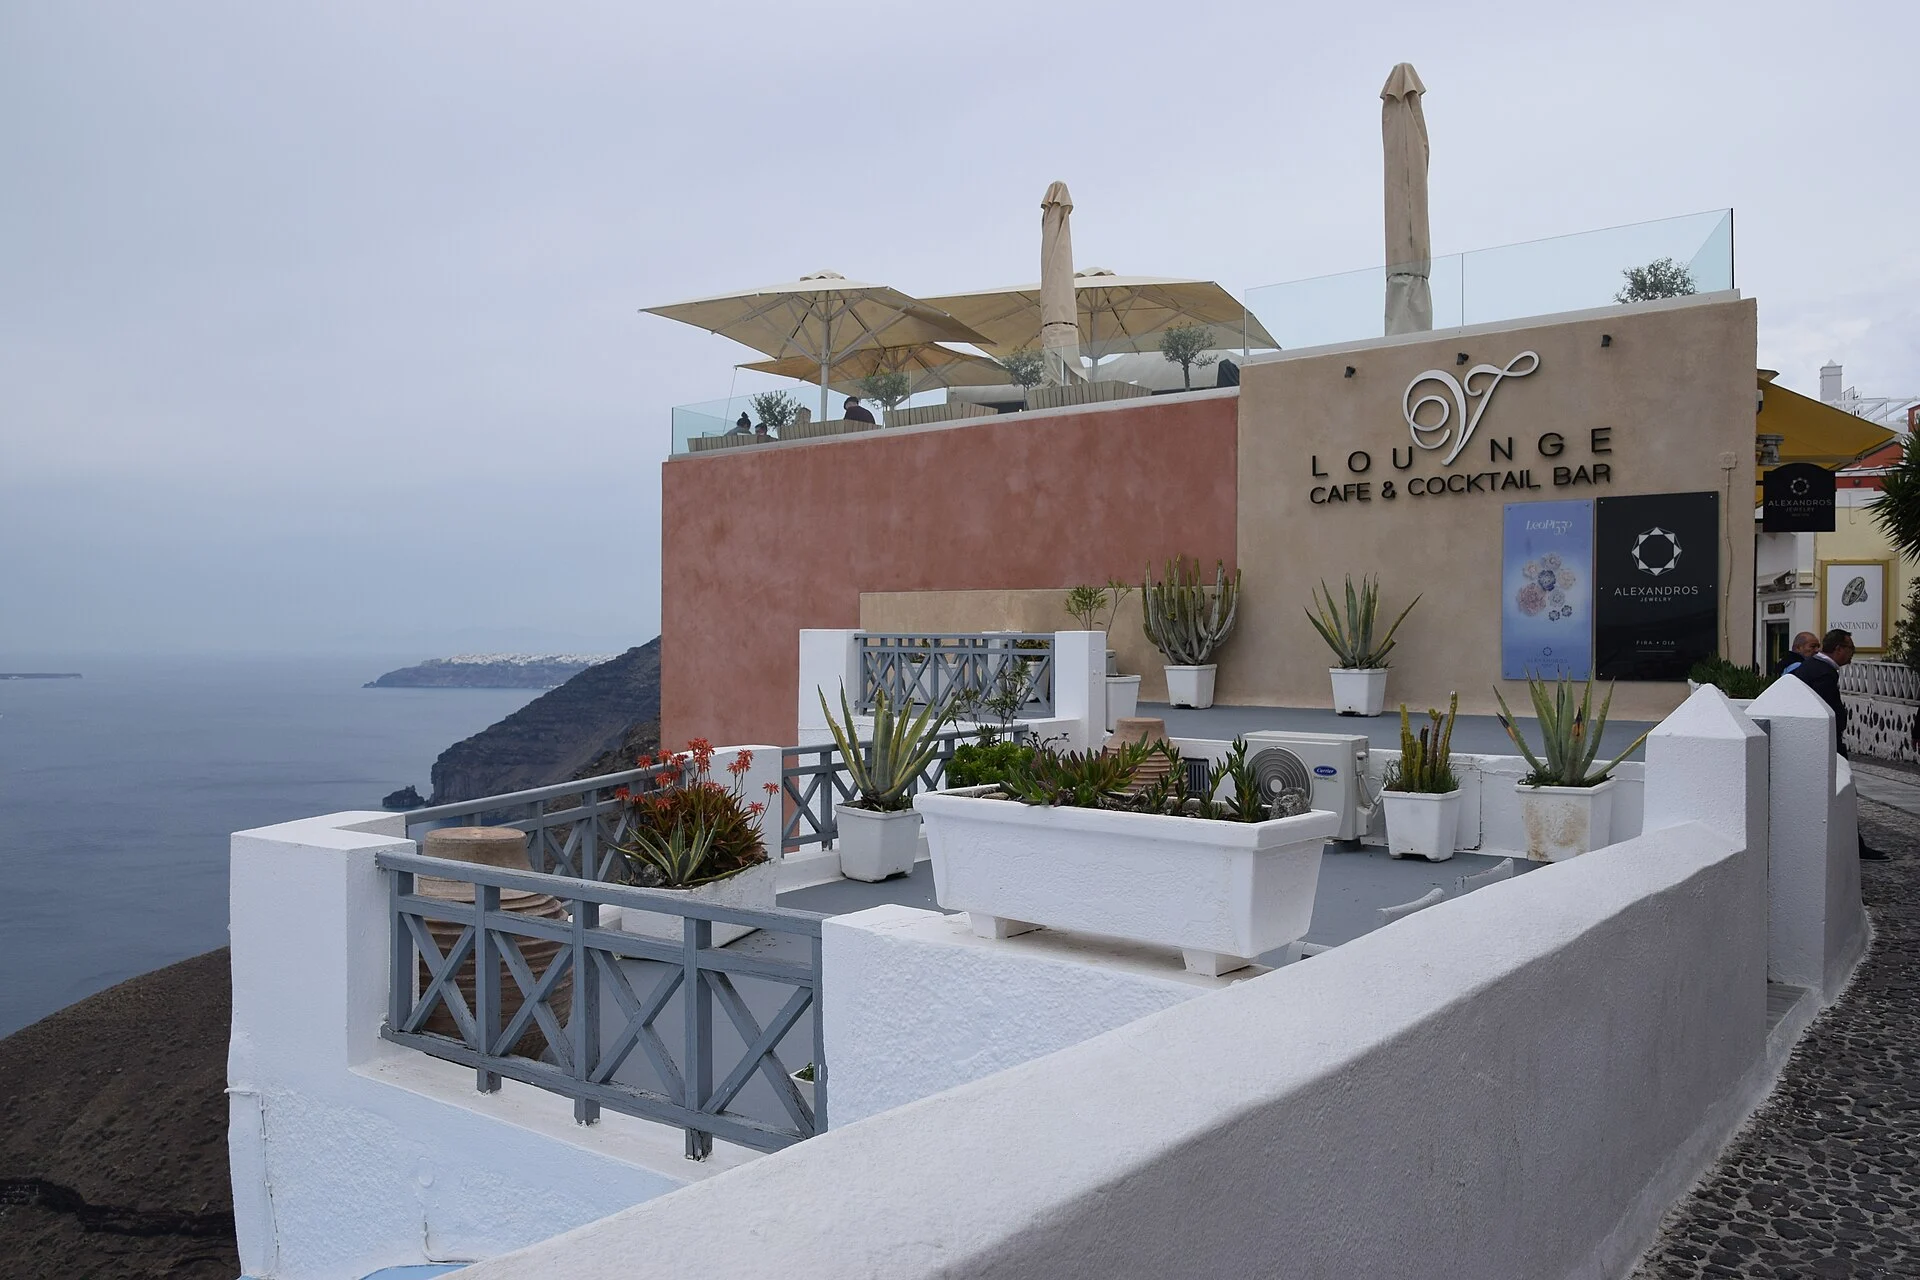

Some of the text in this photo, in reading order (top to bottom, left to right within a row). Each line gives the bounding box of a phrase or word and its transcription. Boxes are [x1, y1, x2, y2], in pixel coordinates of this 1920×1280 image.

[1309, 463, 1612, 504] CAFE & COCKTAIL BAR
[1768, 499, 1832, 507] ALEXANDROS
[1614, 586, 1699, 596] ALEXANDROS
[1830, 621, 1878, 630] KONSTANTINO
